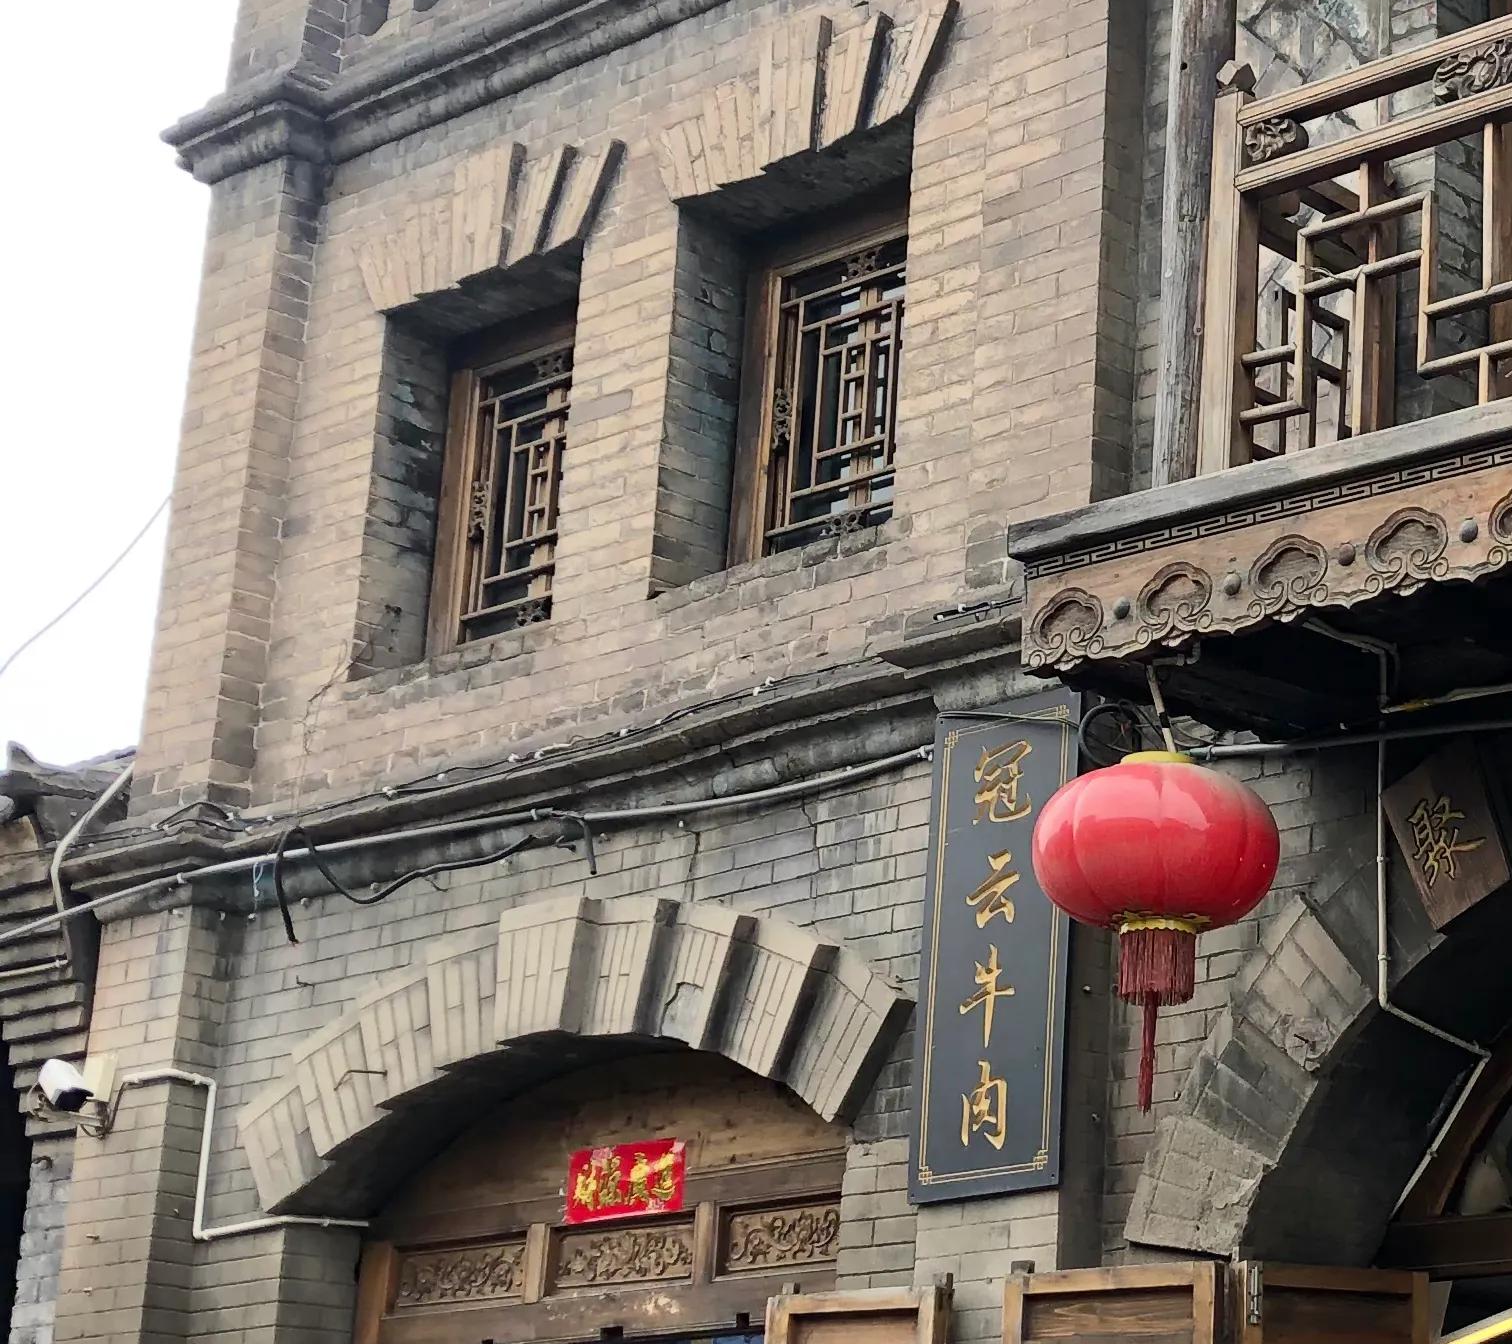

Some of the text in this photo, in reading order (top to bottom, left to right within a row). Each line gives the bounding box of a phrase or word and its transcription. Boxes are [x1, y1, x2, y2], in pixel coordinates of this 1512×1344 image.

[957, 740, 1032, 1150] 冠云牛肉
[1408, 796, 1488, 888] 聚
